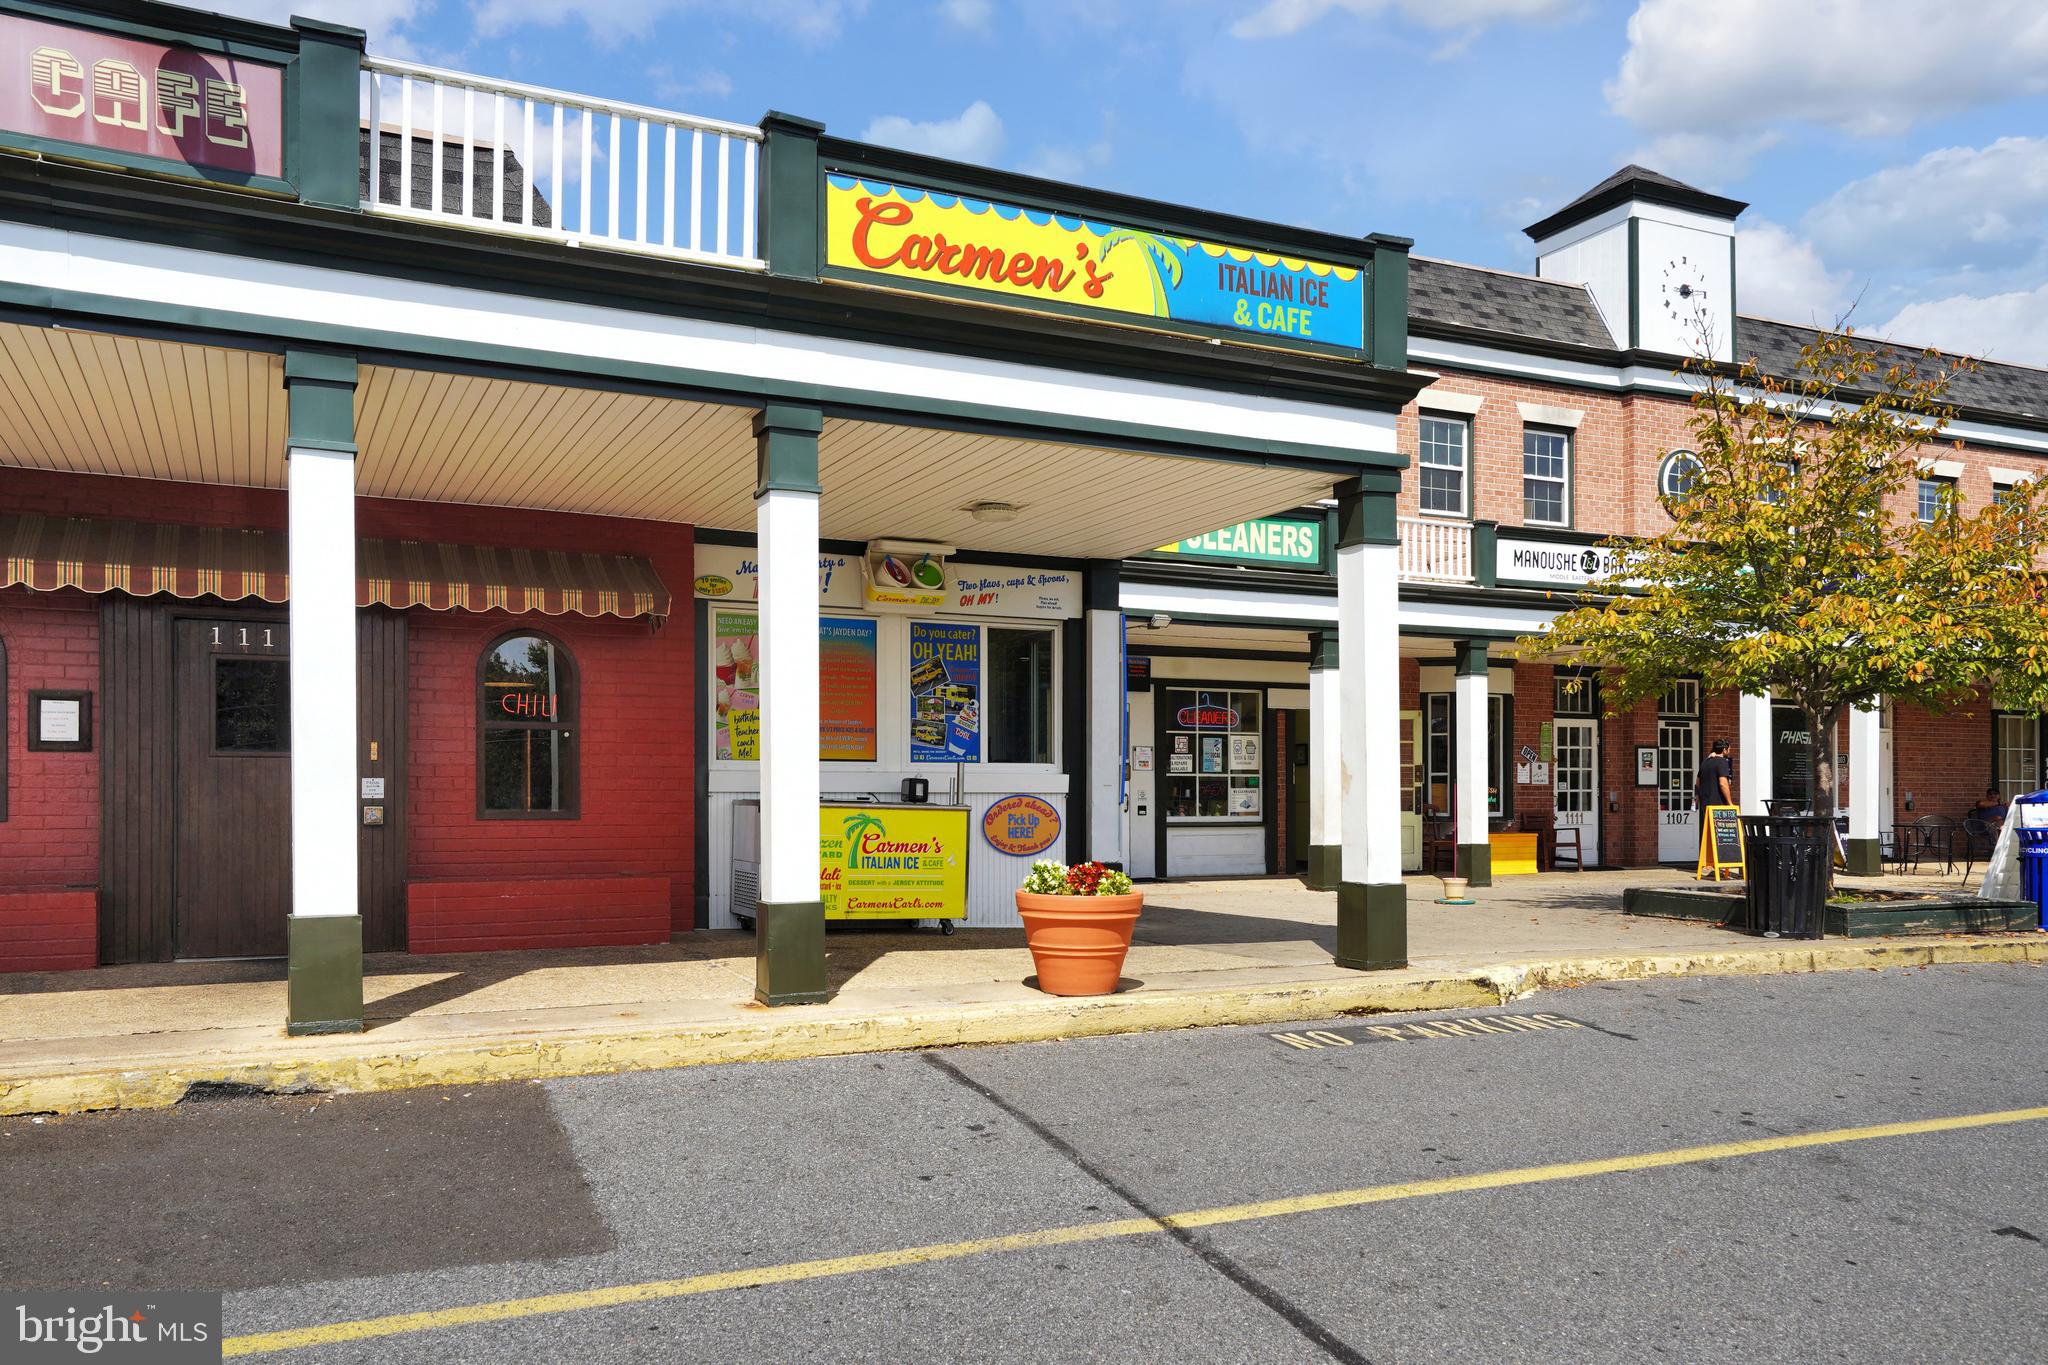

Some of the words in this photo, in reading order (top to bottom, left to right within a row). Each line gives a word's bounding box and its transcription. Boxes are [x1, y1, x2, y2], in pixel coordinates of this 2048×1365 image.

[31, 46, 248, 148] CAFE
[852, 197, 1114, 299] Carmen's
[1217, 263, 1294, 300] ITALIAN
[1299, 277, 1328, 308] ICE
[1233, 299, 1253, 327] &
[1258, 304, 1311, 336] CAFE
[1514, 549, 1577, 572] MANOUSHE
[958, 580, 978, 592] Two
[1006, 577, 1025, 589] cups
[1027, 574, 1036, 586] &
[1038, 574, 1070, 586] spoons,
[959, 594, 973, 607] OH
[717, 617, 733, 625] NEED
[819, 626, 832, 636] AT'S
[833, 627, 856, 637] JAYDEN
[857, 628, 872, 637] DAY?
[913, 625, 926, 637] Do
[929, 629, 946, 641] you
[948, 629, 976, 640] cater?
[913, 642, 932, 659] OH
[937, 643, 977, 662] YEAH!
[502, 692, 557, 717] CHILI
[1180, 709, 1237, 724] CLEANERS
[737, 738, 755, 747] coach
[1522, 747, 1537, 762] OPEN
[986, 798, 1023, 826] Ordered
[1565, 812, 1584, 824] 1111
[1666, 813, 1690, 825] 1107
[1008, 813, 1026, 826] Pick
[1028, 813, 1040, 828] Up
[1008, 827, 1034, 839] HERE!
[862, 833, 944, 854] Carmen's
[861, 856, 900, 869] ITALIAN
[903, 856, 919, 869] ICE
[928, 859, 944, 867] CAFE
[1271, 1031, 1354, 1050] NO
[1366, 1014, 1585, 1041] PARKING
